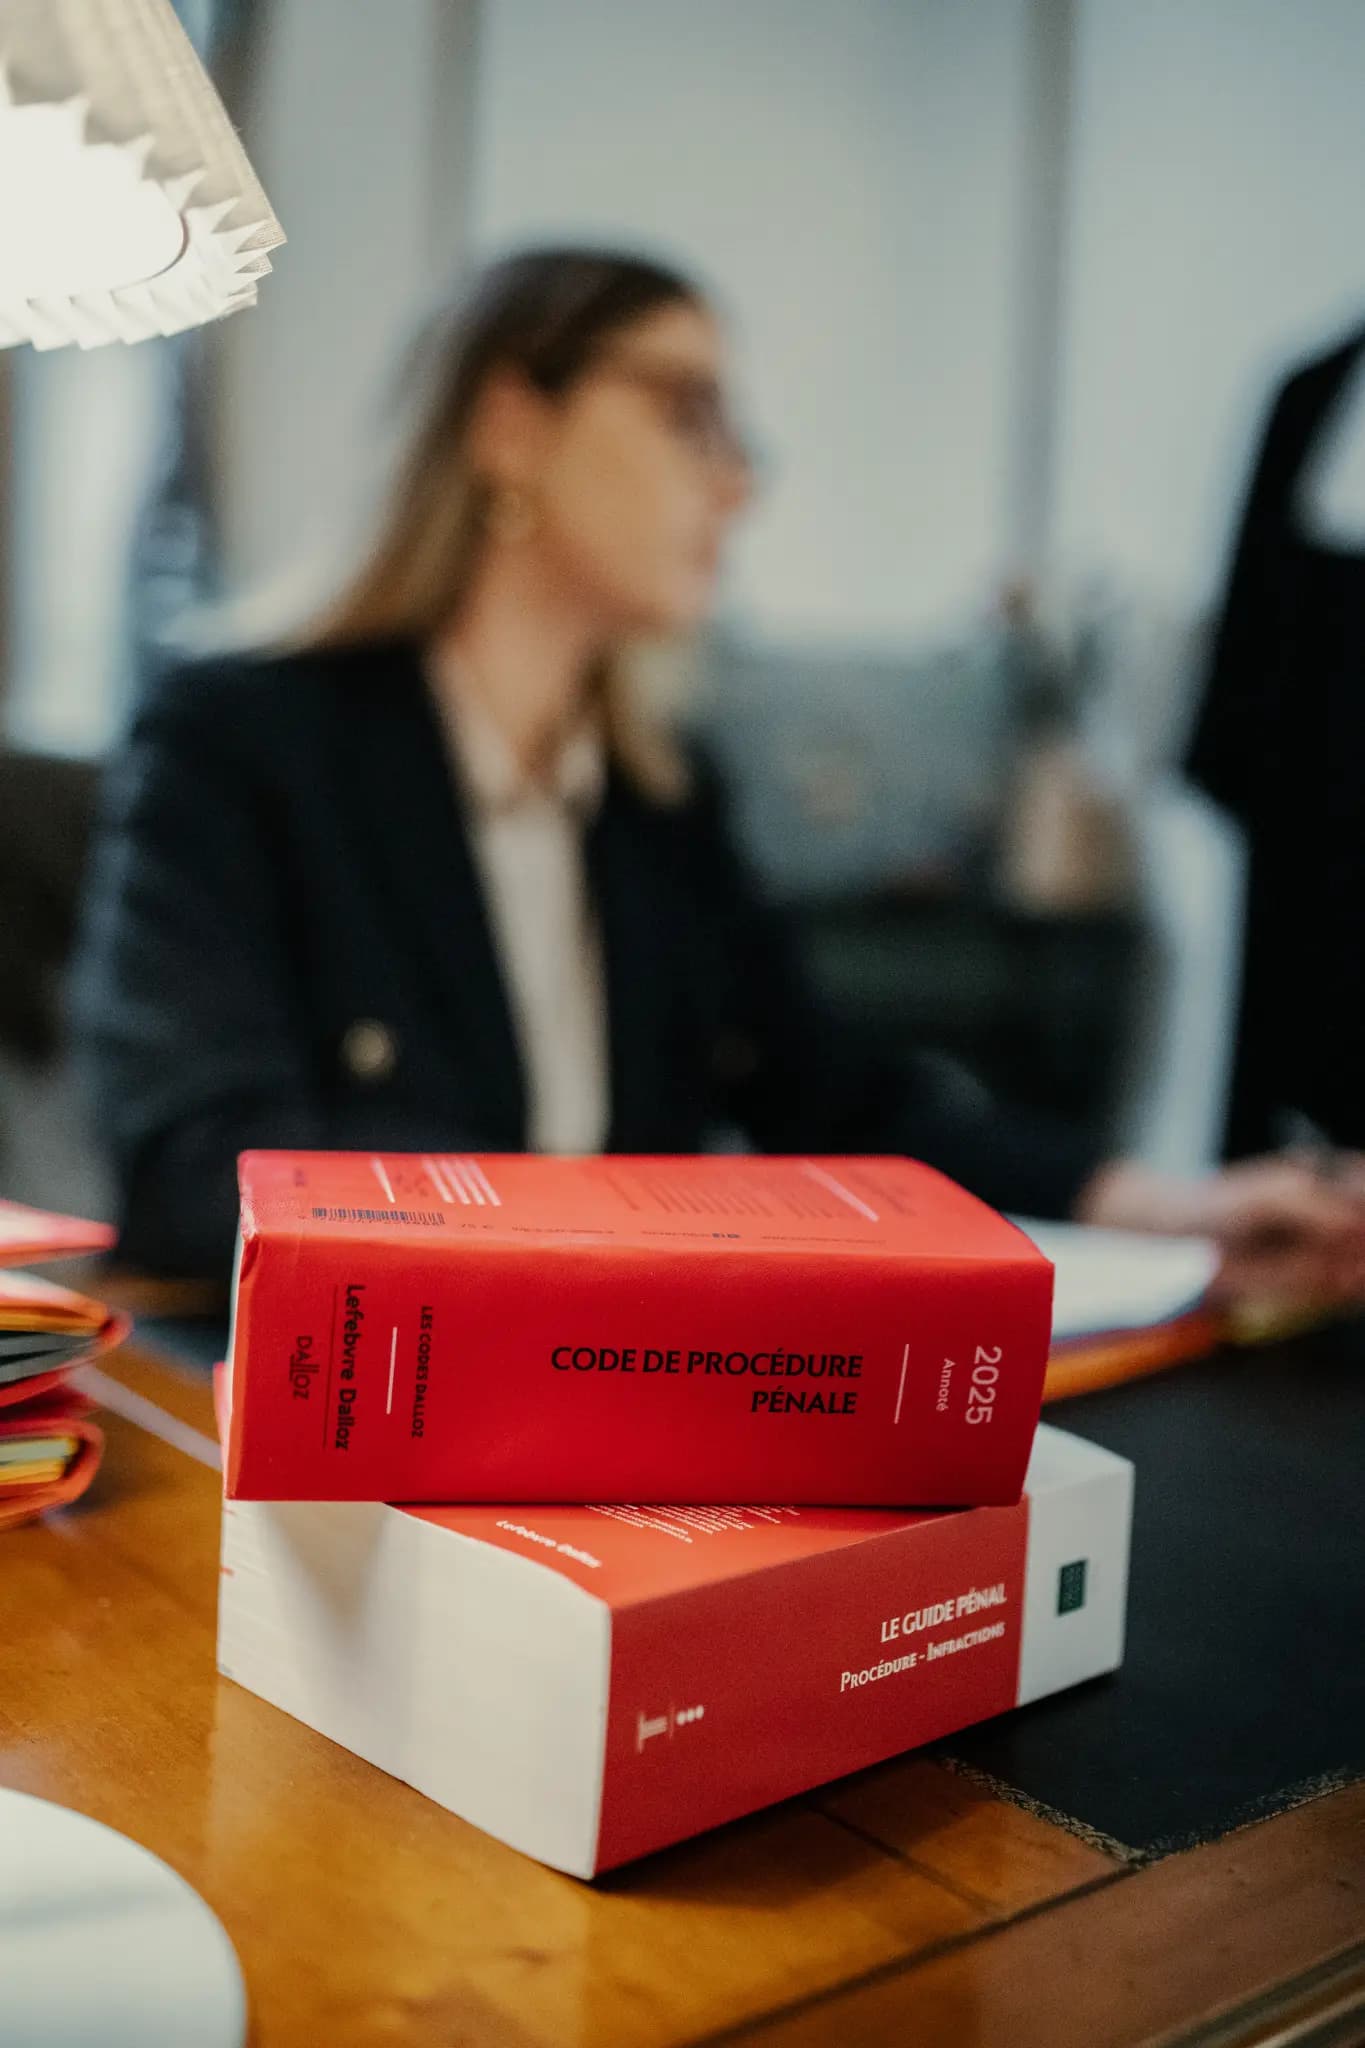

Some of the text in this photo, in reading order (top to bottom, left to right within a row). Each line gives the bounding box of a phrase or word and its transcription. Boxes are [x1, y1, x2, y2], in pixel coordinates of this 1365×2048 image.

[335, 1284, 366, 1450] Lefebvre Dalloz
[411, 1306, 433, 1439] LES CODES DALLOZ
[551, 1346, 864, 1378] CODE DE PROCÉDURE
[935, 1358, 957, 1412] Annoté
[965, 1345, 1003, 1425] 2025
[751, 1385, 857, 1415] PÉNALE
[880, 1583, 1008, 1643] LE GUIDE PÉNAL
